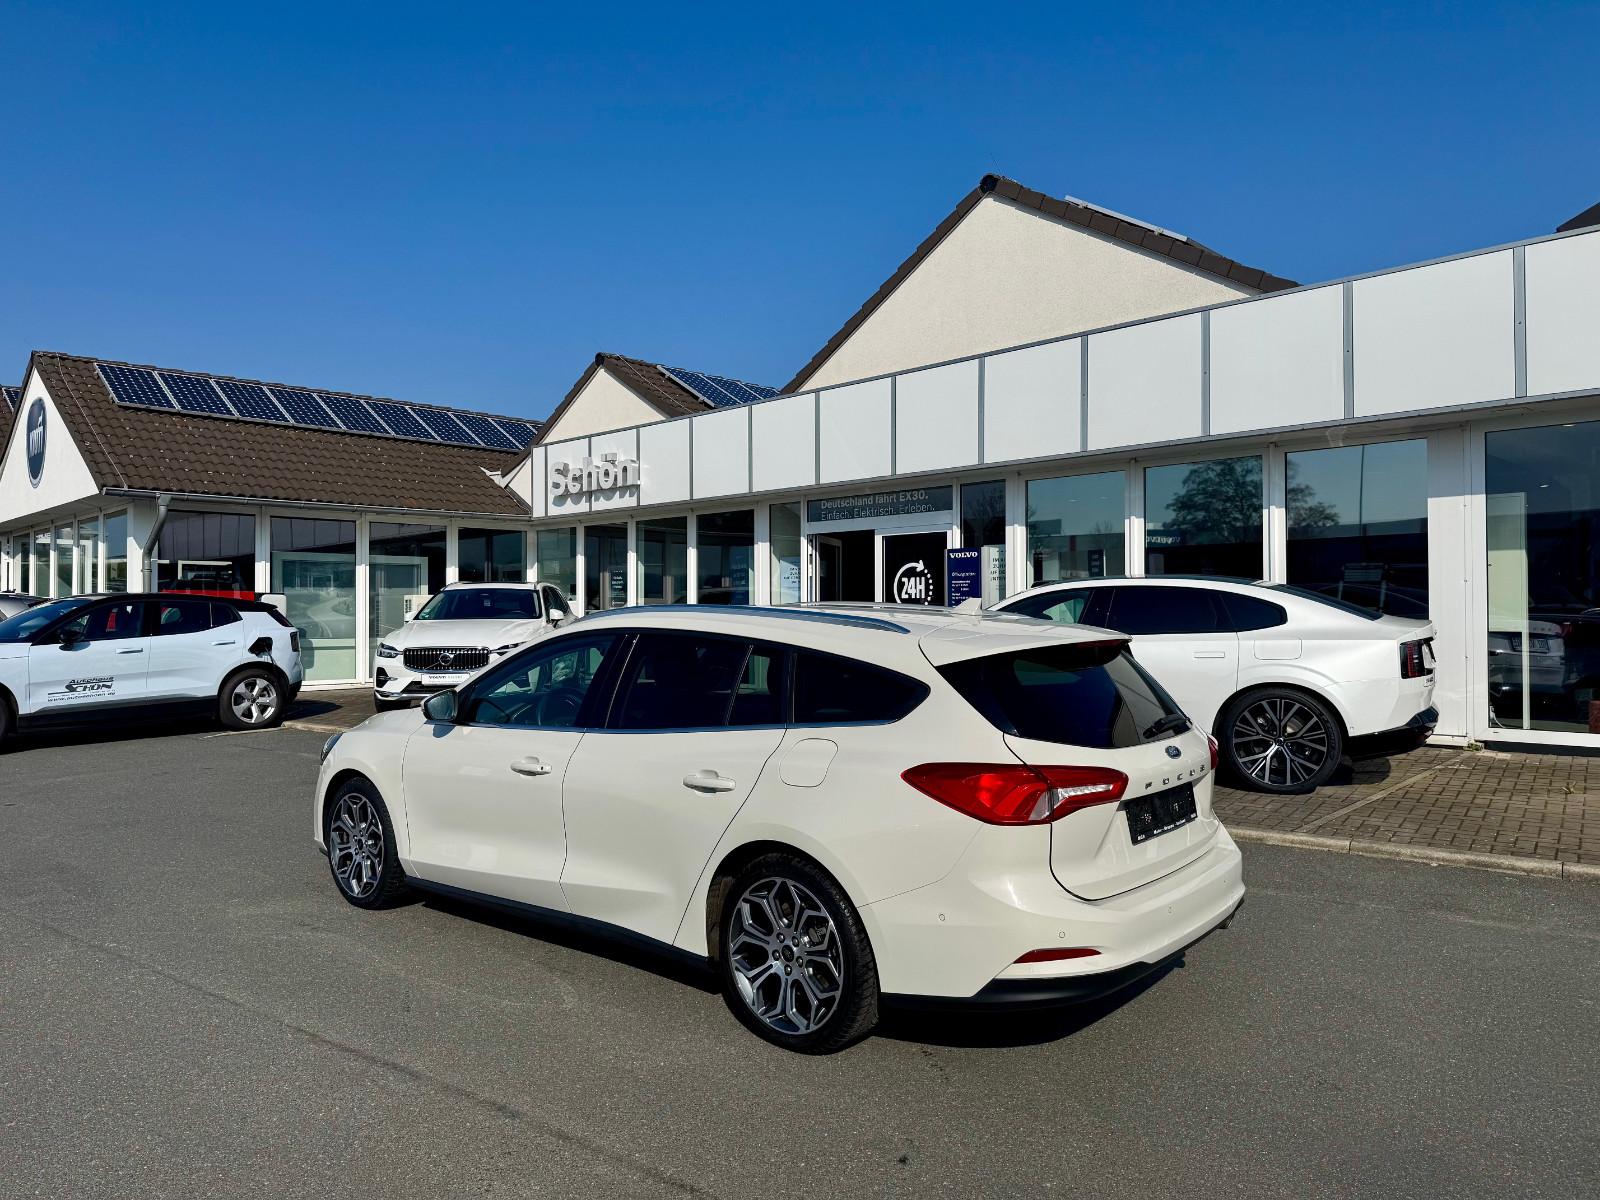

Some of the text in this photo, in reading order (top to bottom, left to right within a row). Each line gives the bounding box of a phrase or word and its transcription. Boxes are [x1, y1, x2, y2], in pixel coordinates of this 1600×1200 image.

[821, 489, 929, 509] Deutschland fährt EX30.
[821, 501, 935, 521] Einfach. Elektrisch. Erleben.
[949, 551, 979, 559] VOLVO
[901, 576, 926, 599] 24H
[69, 676, 114, 684] Autohaus
[1144, 764, 1206, 791] FOCUS
